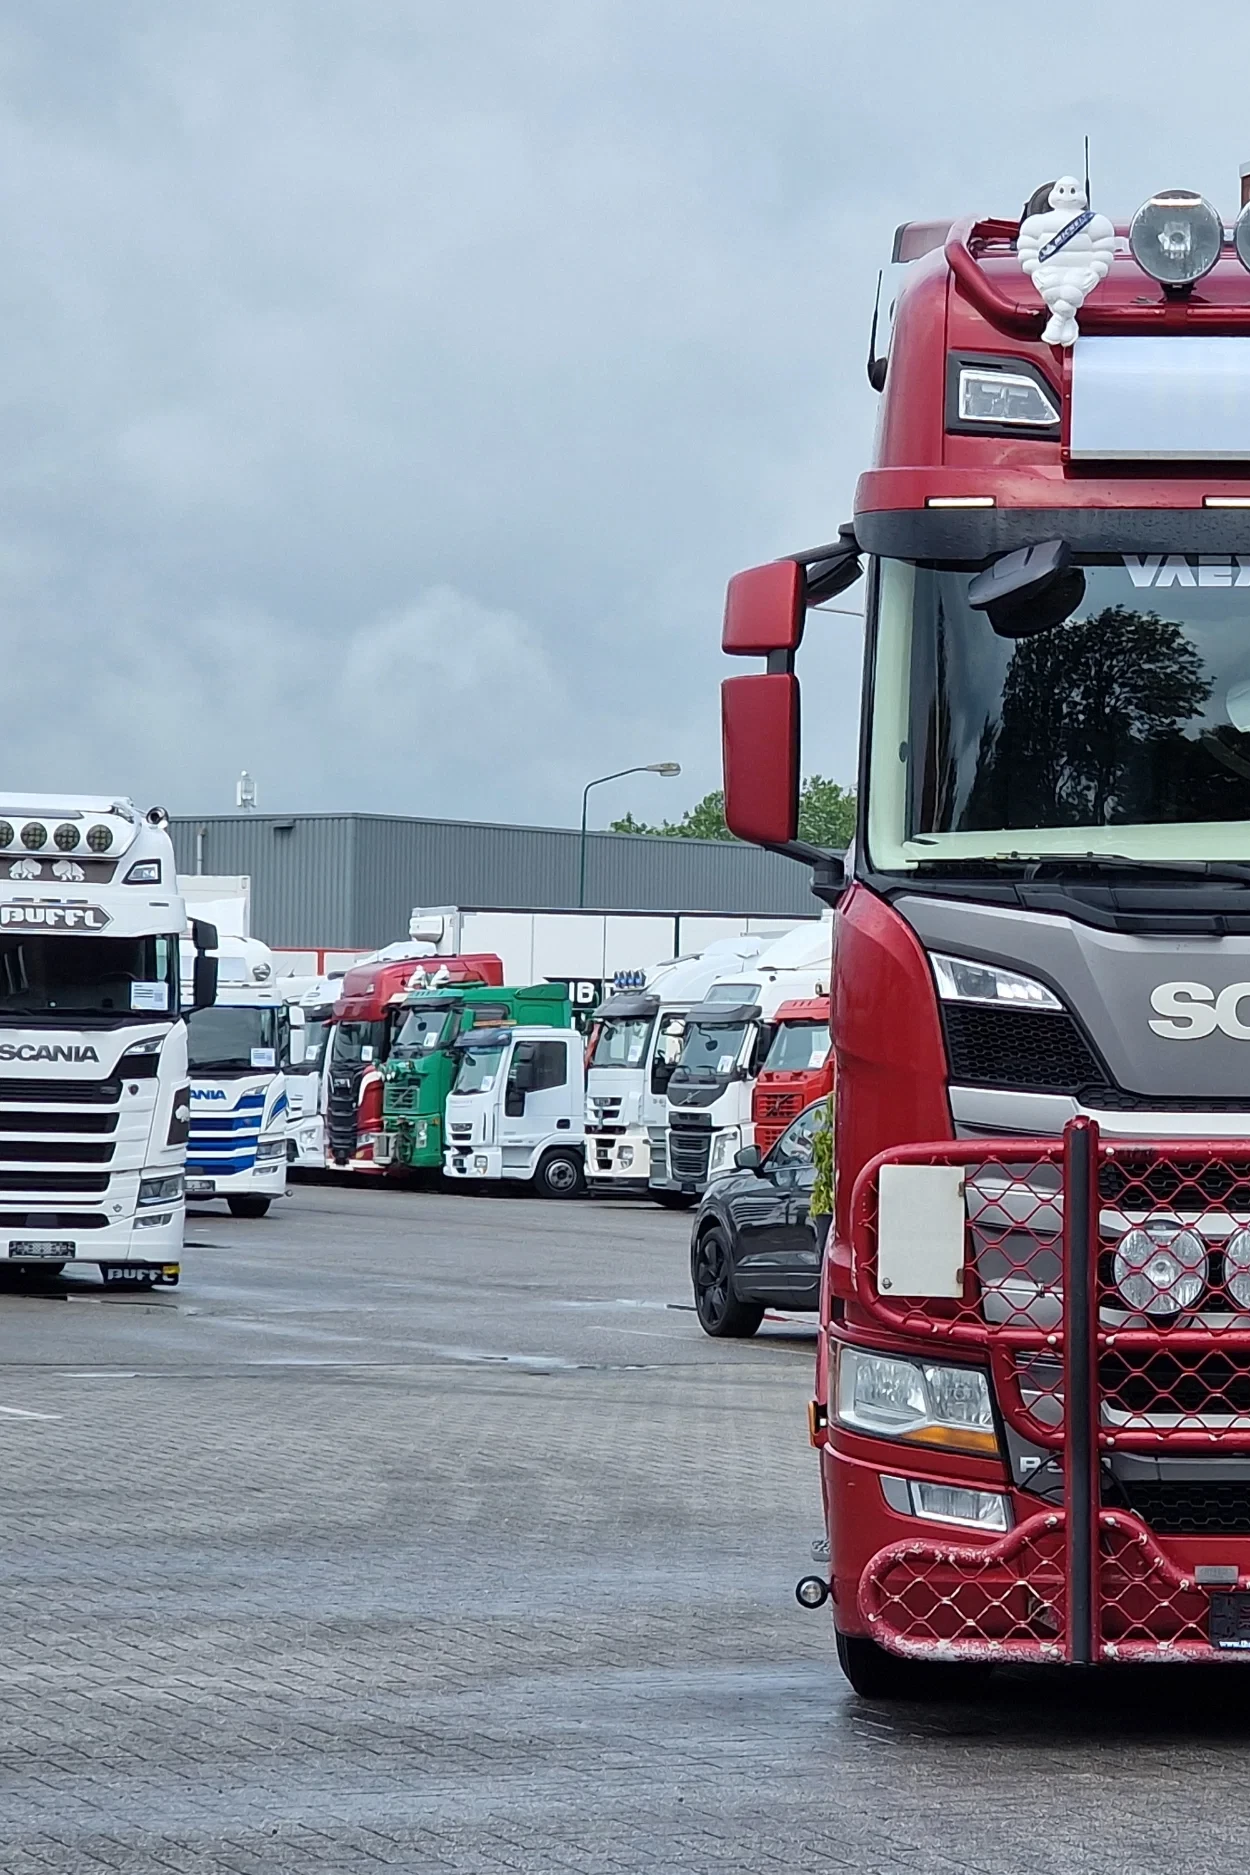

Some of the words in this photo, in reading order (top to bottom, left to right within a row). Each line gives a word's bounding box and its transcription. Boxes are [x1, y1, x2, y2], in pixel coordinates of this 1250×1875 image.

[0, 907, 103, 928] BUFFL
[0, 1044, 100, 1062] SCANIA
[190, 1089, 227, 1101] ANIA
